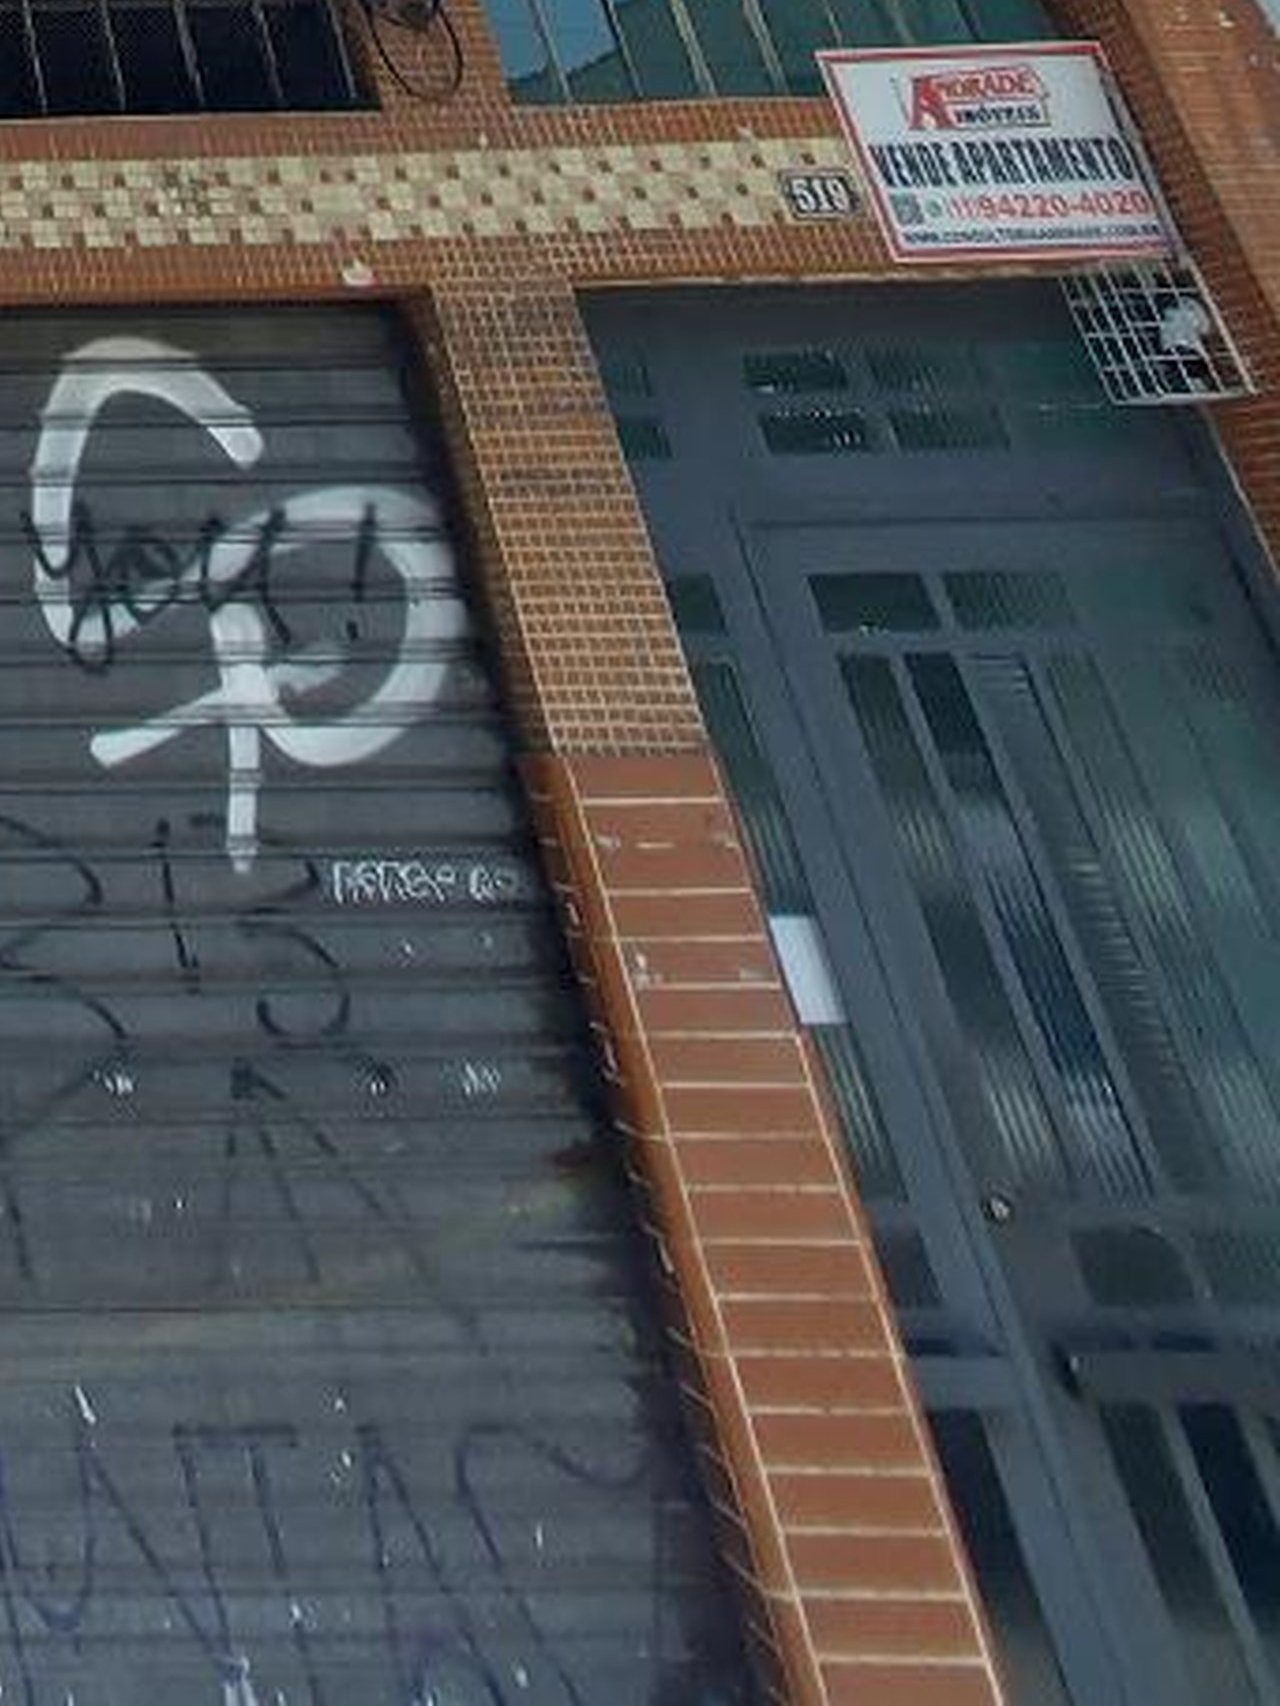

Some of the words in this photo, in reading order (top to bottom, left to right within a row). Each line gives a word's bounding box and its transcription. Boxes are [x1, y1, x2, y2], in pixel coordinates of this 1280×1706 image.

[868, 141, 957, 187] VENDE
[950, 137, 1135, 186] APARTAMENTO
[792, 178, 850, 211] 519
